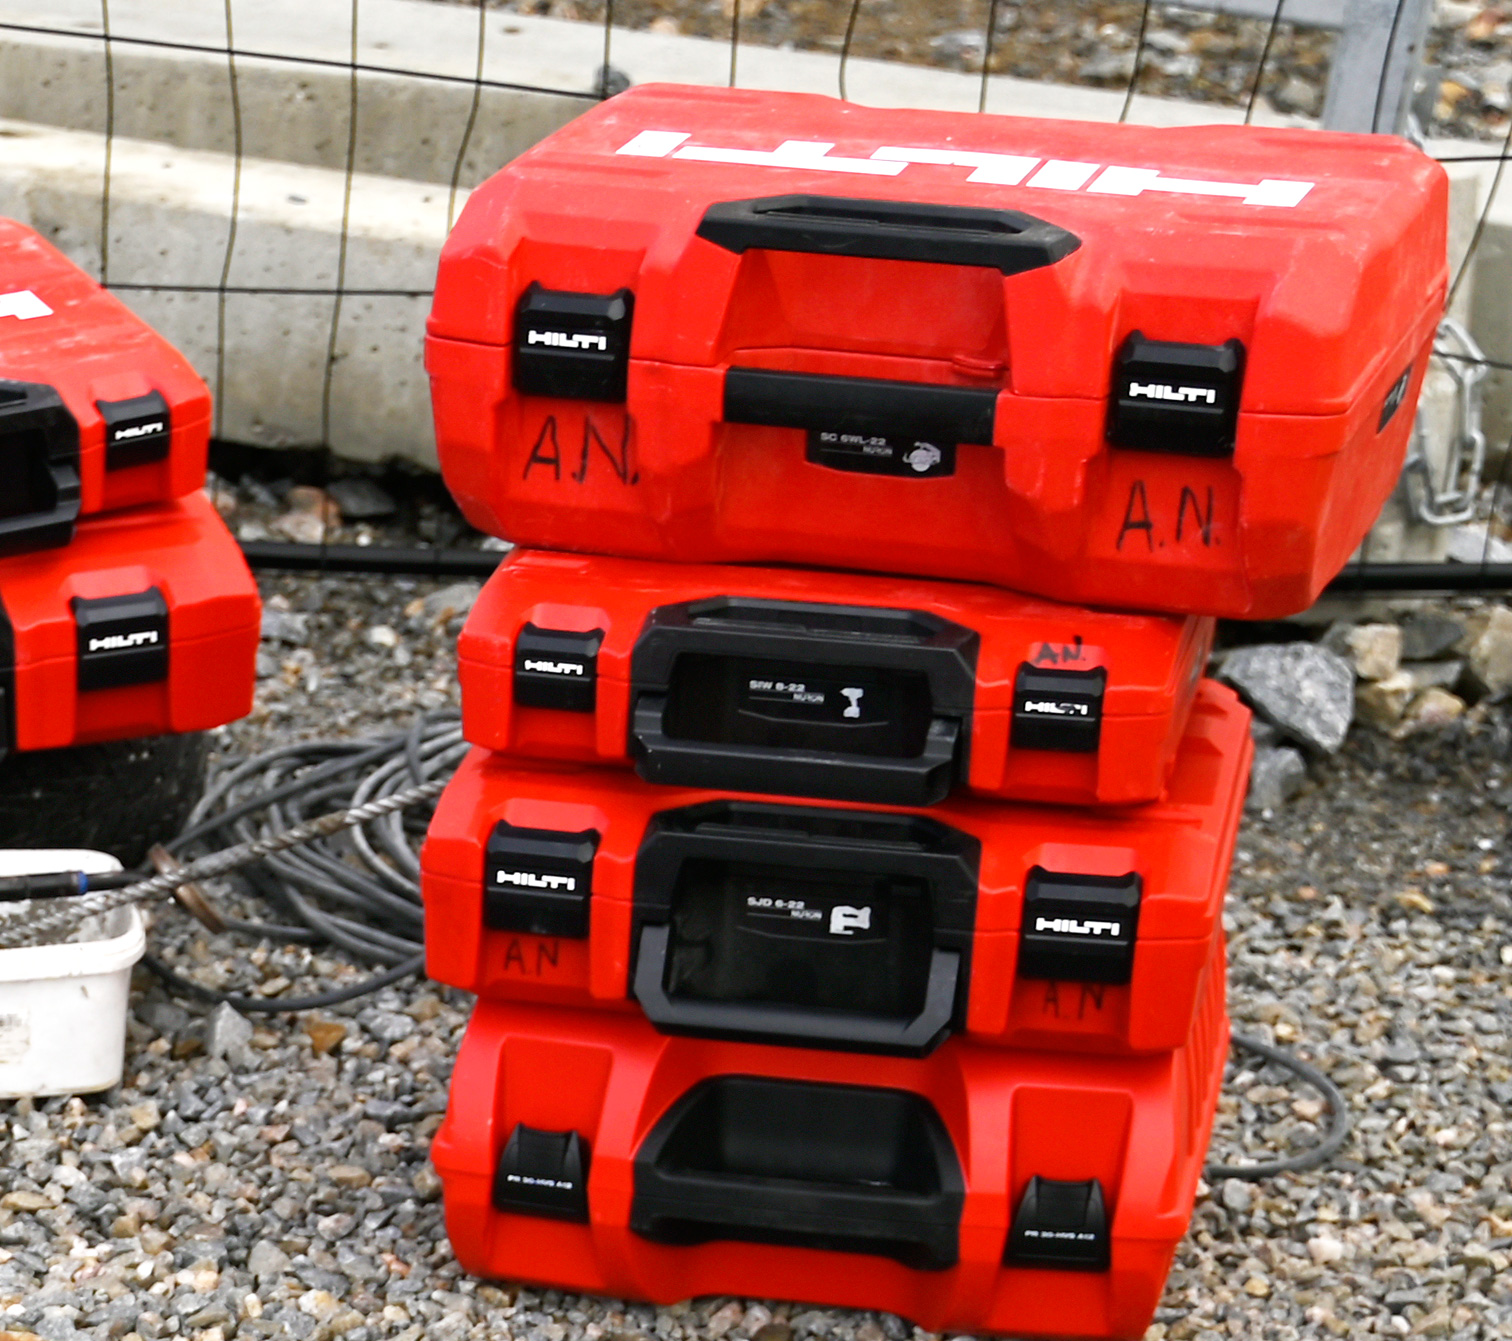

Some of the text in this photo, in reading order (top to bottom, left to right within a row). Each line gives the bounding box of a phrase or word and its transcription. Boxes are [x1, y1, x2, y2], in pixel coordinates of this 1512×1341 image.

[615, 130, 1316, 207] HILTI
[528, 330, 607, 350] HILTI
[1129, 382, 1216, 403] HILTI
[114, 421, 163, 440] HILTI
[89, 631, 158, 651] HILTI
[524, 659, 583, 675] HILTI
[496, 870, 576, 890] HILTI
[1036, 917, 1120, 936] HILTI
